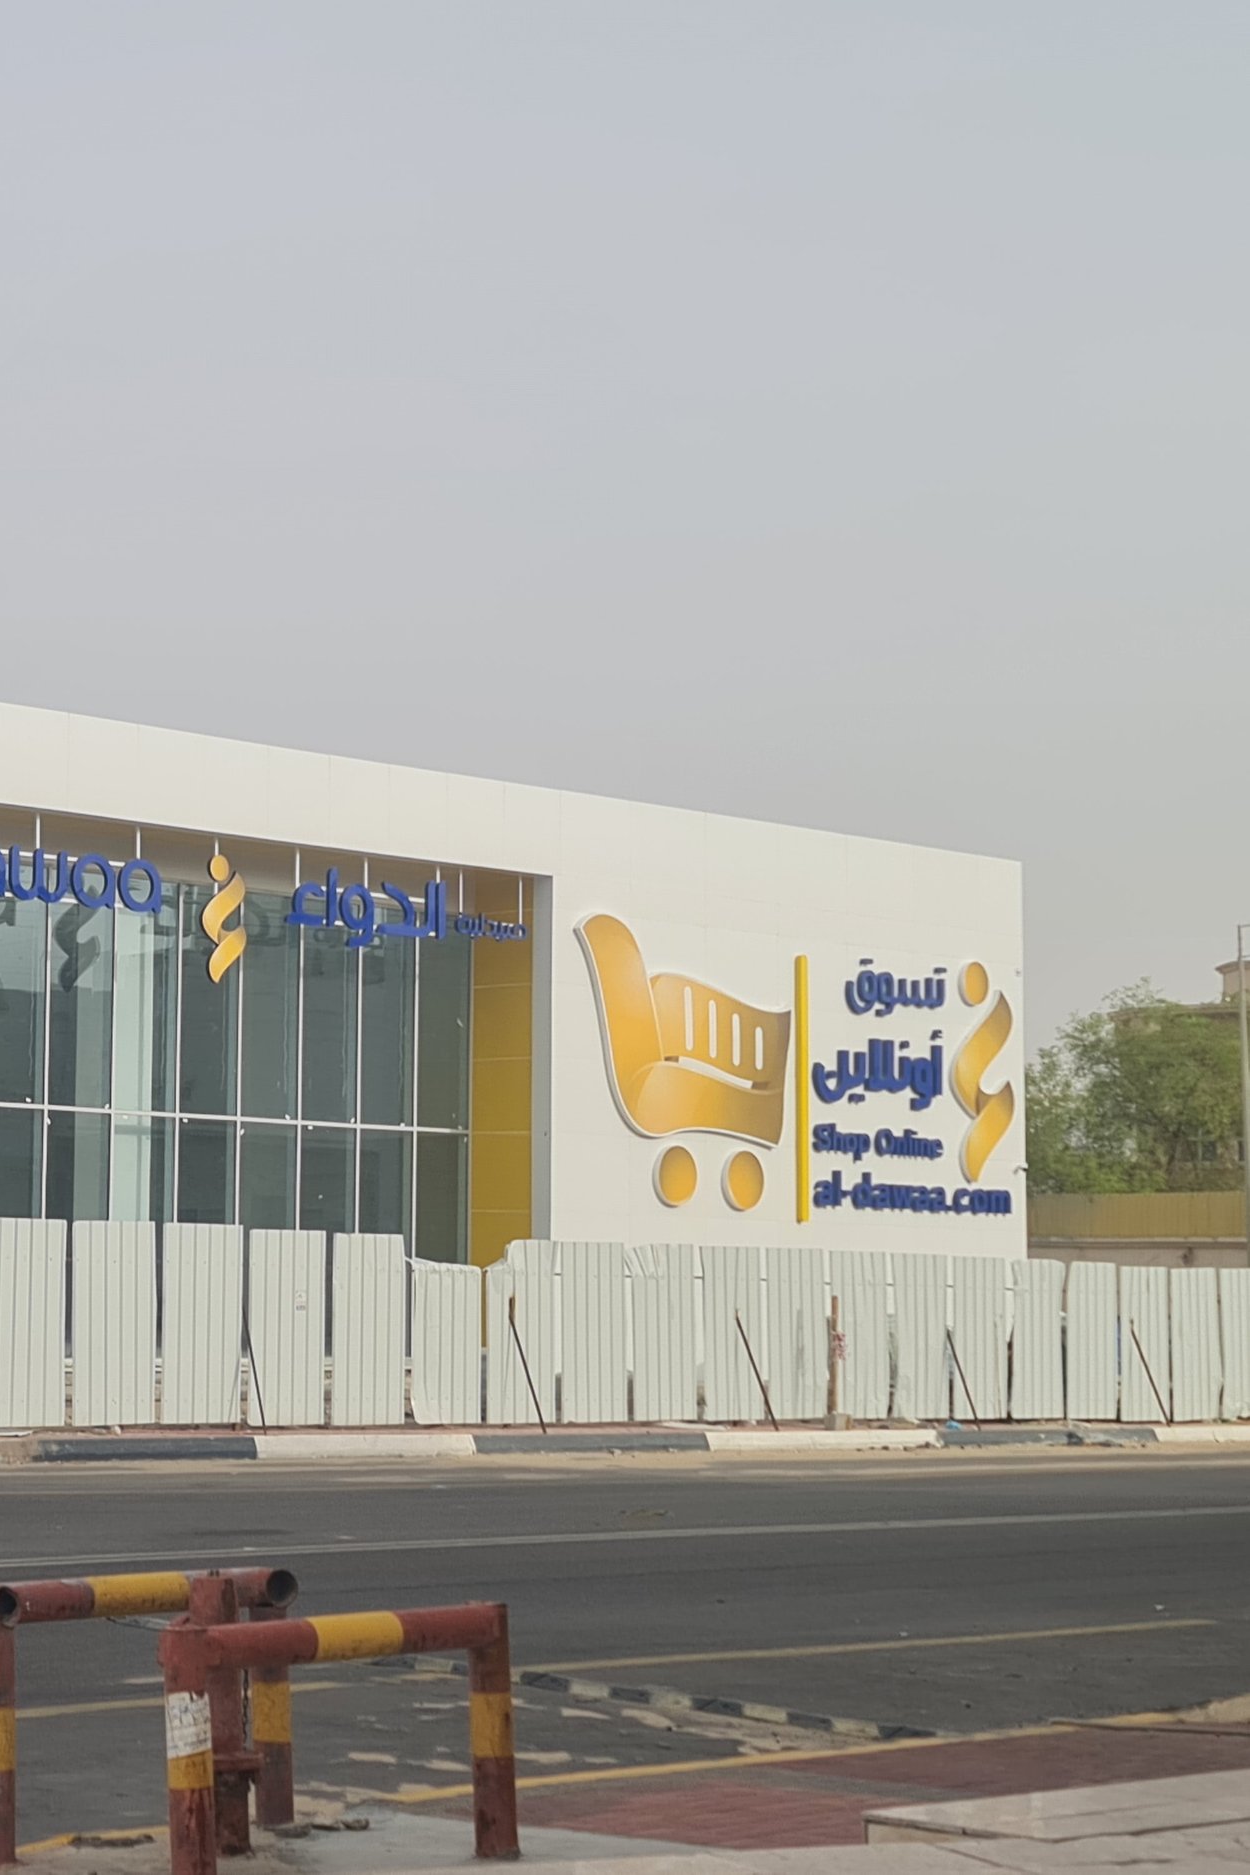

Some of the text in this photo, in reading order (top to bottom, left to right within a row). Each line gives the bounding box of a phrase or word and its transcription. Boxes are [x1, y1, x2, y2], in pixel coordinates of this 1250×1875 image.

[284, 867, 446, 948] الدواء
[812, 1029, 944, 1112] أونلاين
[812, 1123, 944, 1163] Shop Online
[812, 1170, 1012, 1216] al-dawaa.com
